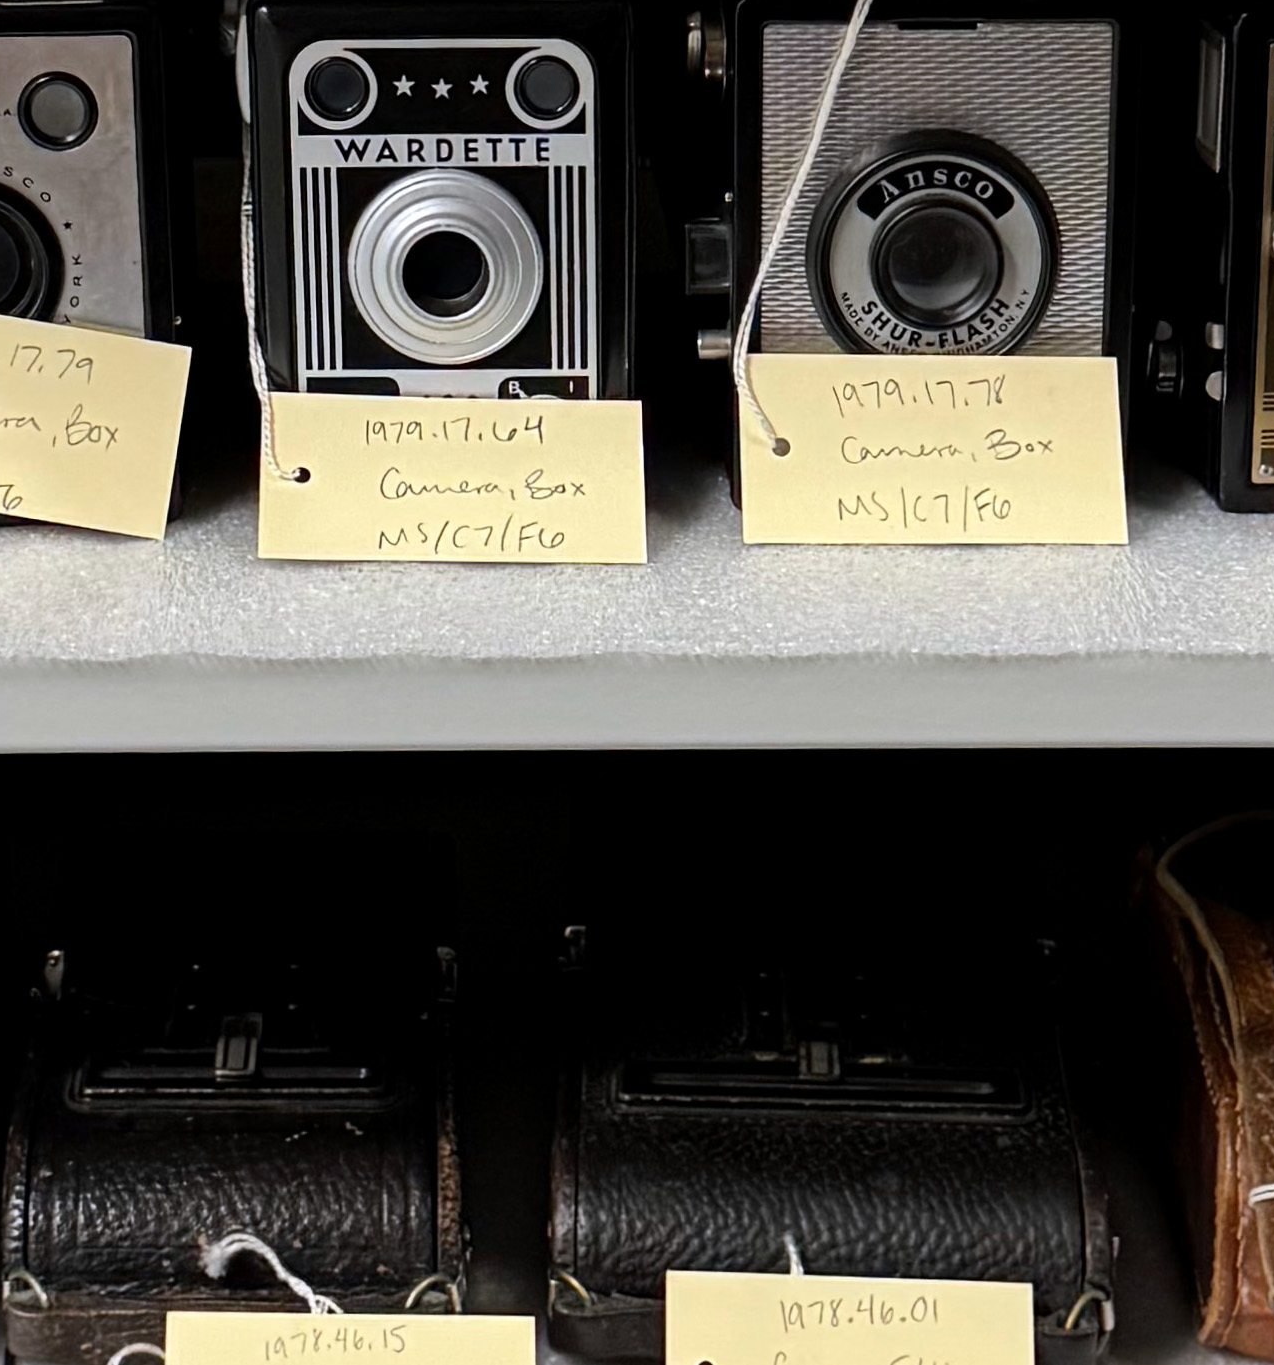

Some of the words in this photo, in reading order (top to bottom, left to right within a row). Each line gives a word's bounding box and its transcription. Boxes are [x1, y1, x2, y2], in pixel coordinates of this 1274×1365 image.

[334, 138, 550, 163] WARDETTE
[861, 298, 1011, 350] SHUR-FLASH
[834, 374, 1006, 417] 1979.17.78
[65, 404, 119, 451] Box
[365, 415, 544, 446] 1979.17.64
[984, 429, 1053, 461] Box
[525, 469, 586, 499] Box
[838, 486, 1011, 532] MS/C7/F6
[378, 513, 566, 551] MS/C7/F6
[780, 1294, 938, 1332] 1978.46.01
[265, 1324, 407, 1361] 1978.46.15
